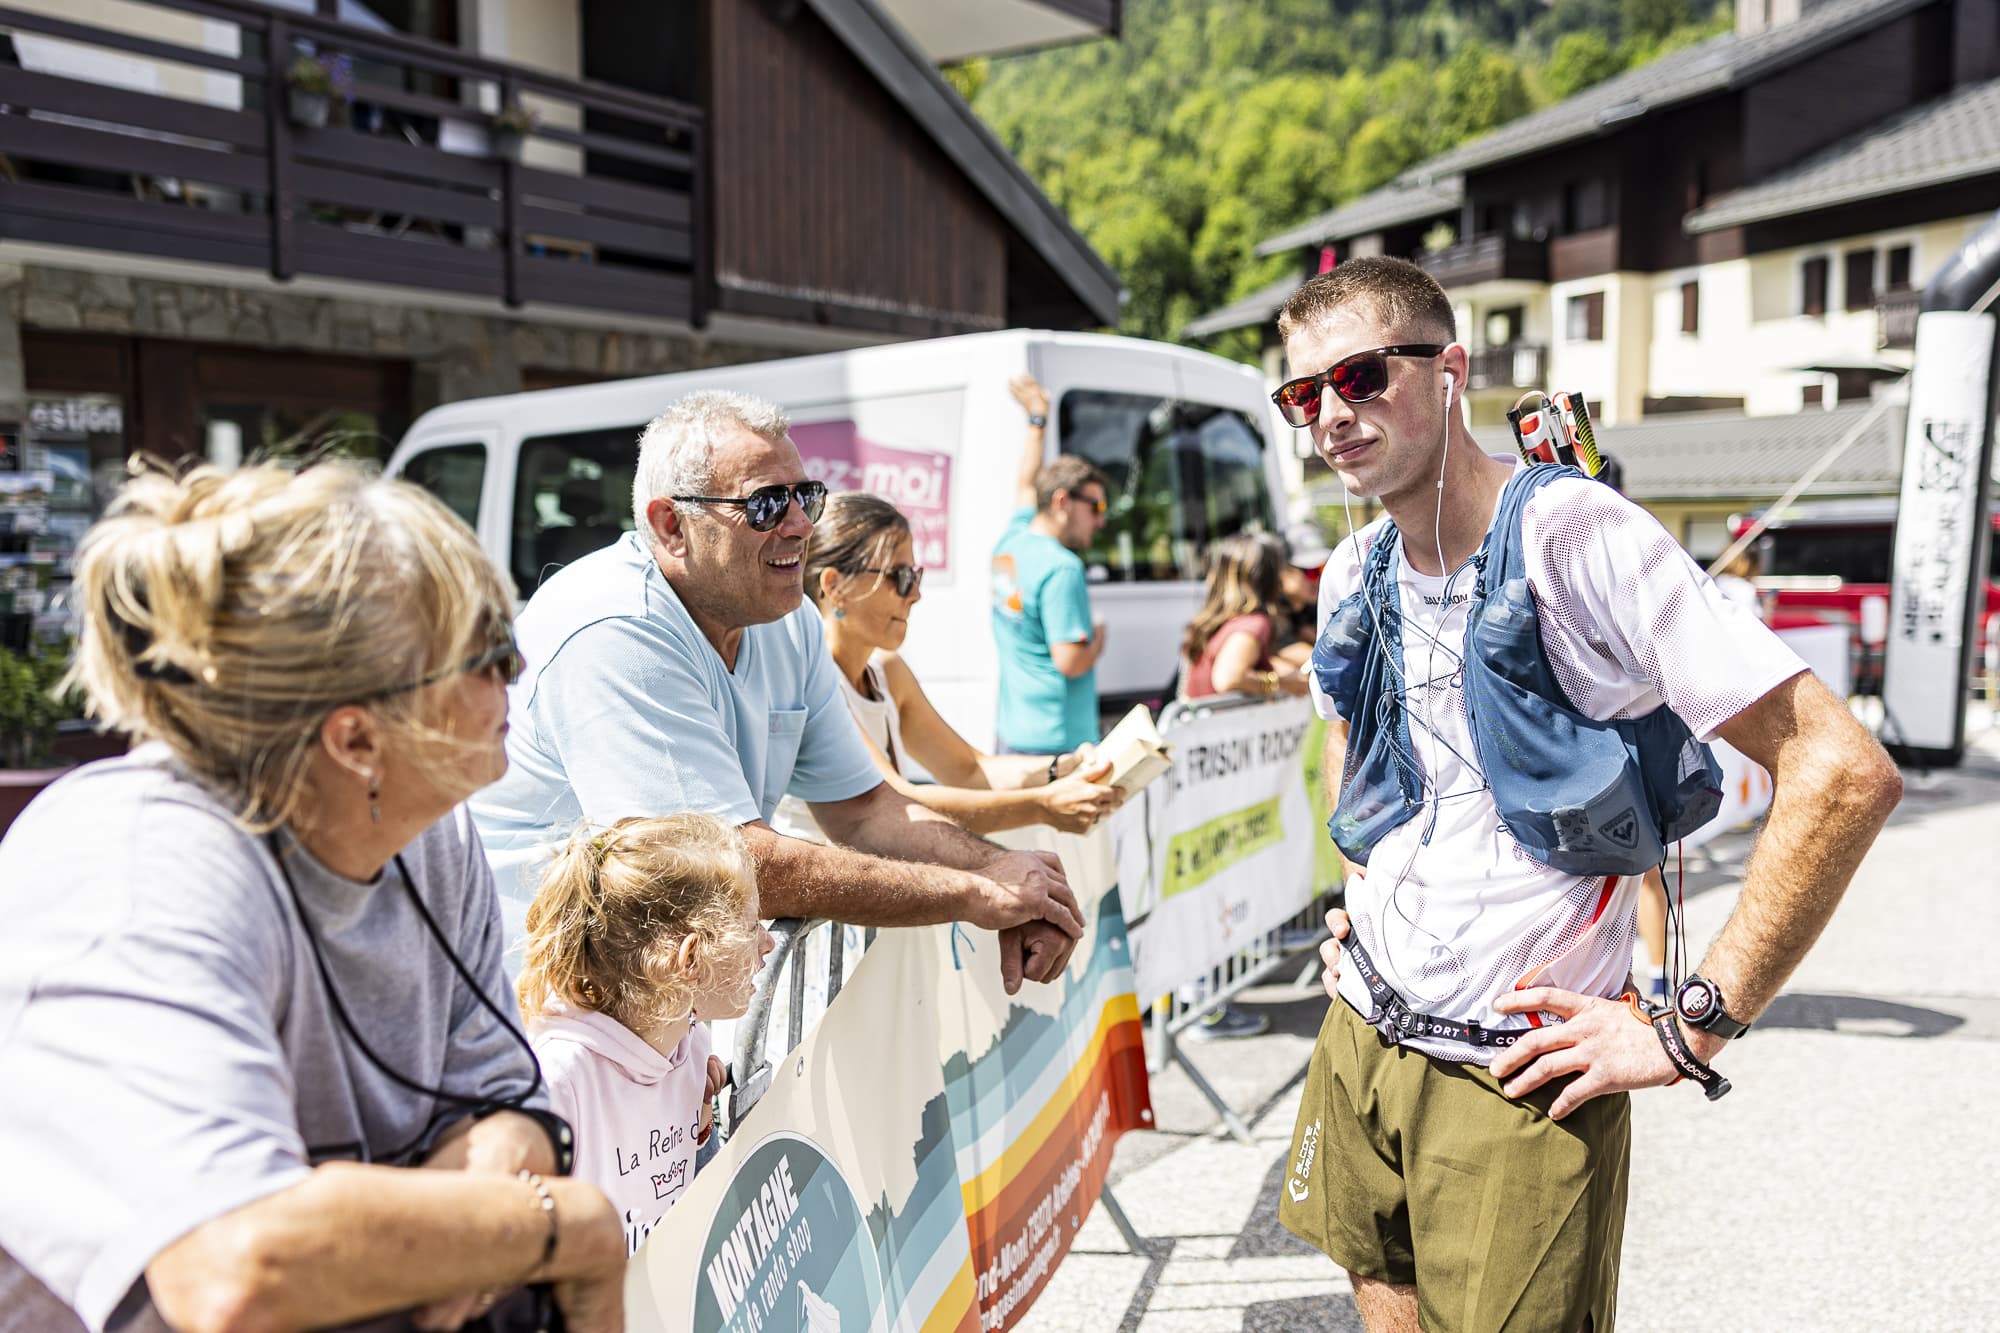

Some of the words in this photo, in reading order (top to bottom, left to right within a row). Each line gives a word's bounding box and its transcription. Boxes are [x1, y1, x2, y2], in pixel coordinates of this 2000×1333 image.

[806, 455, 946, 508] ez-moi
[616, 1147, 640, 1176] La
[649, 1126, 683, 1160] Reine
[690, 1110, 700, 1141] d
[706, 1153, 800, 1328] MONTAGNE
[759, 1253, 788, 1317] rando
[786, 1216, 813, 1269] shop
[978, 1226, 1030, 1301] nd-Mont
